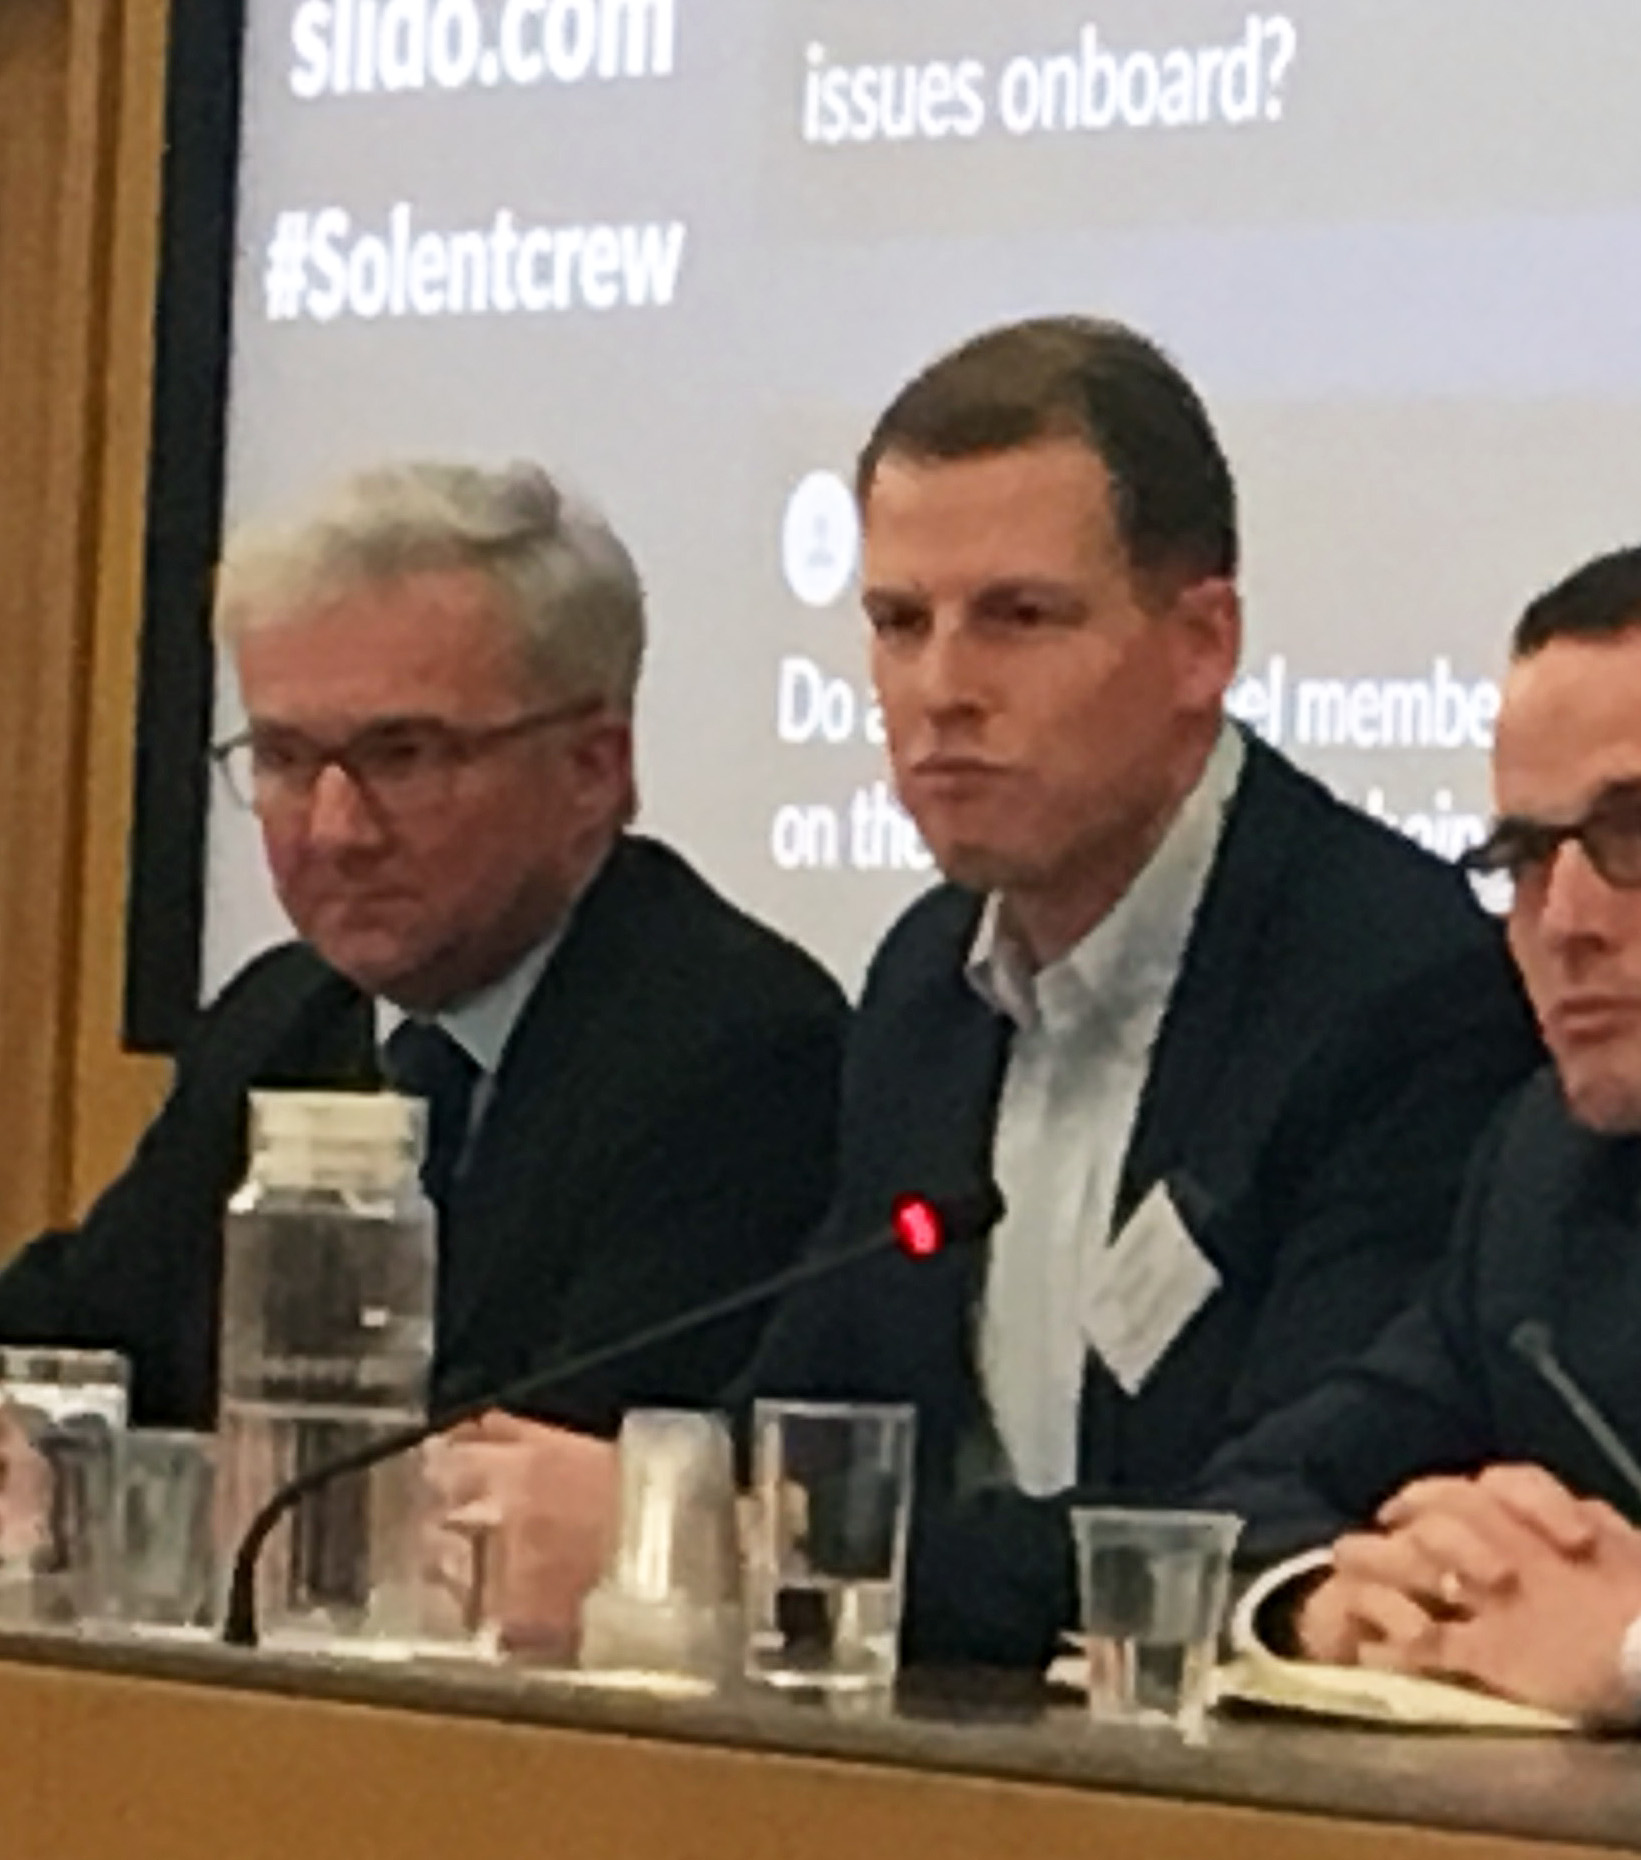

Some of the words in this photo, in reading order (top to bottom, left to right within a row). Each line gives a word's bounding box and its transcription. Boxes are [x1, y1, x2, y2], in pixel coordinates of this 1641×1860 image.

[289, 0, 675, 97] slido.com
[803, 40, 985, 142] issues
[1000, 14, 1297, 132] onboard?
[265, 201, 687, 320] #Solentcrew
[778, 656, 854, 743] Do
[1222, 654, 1287, 746] el
[772, 805, 838, 868] on
